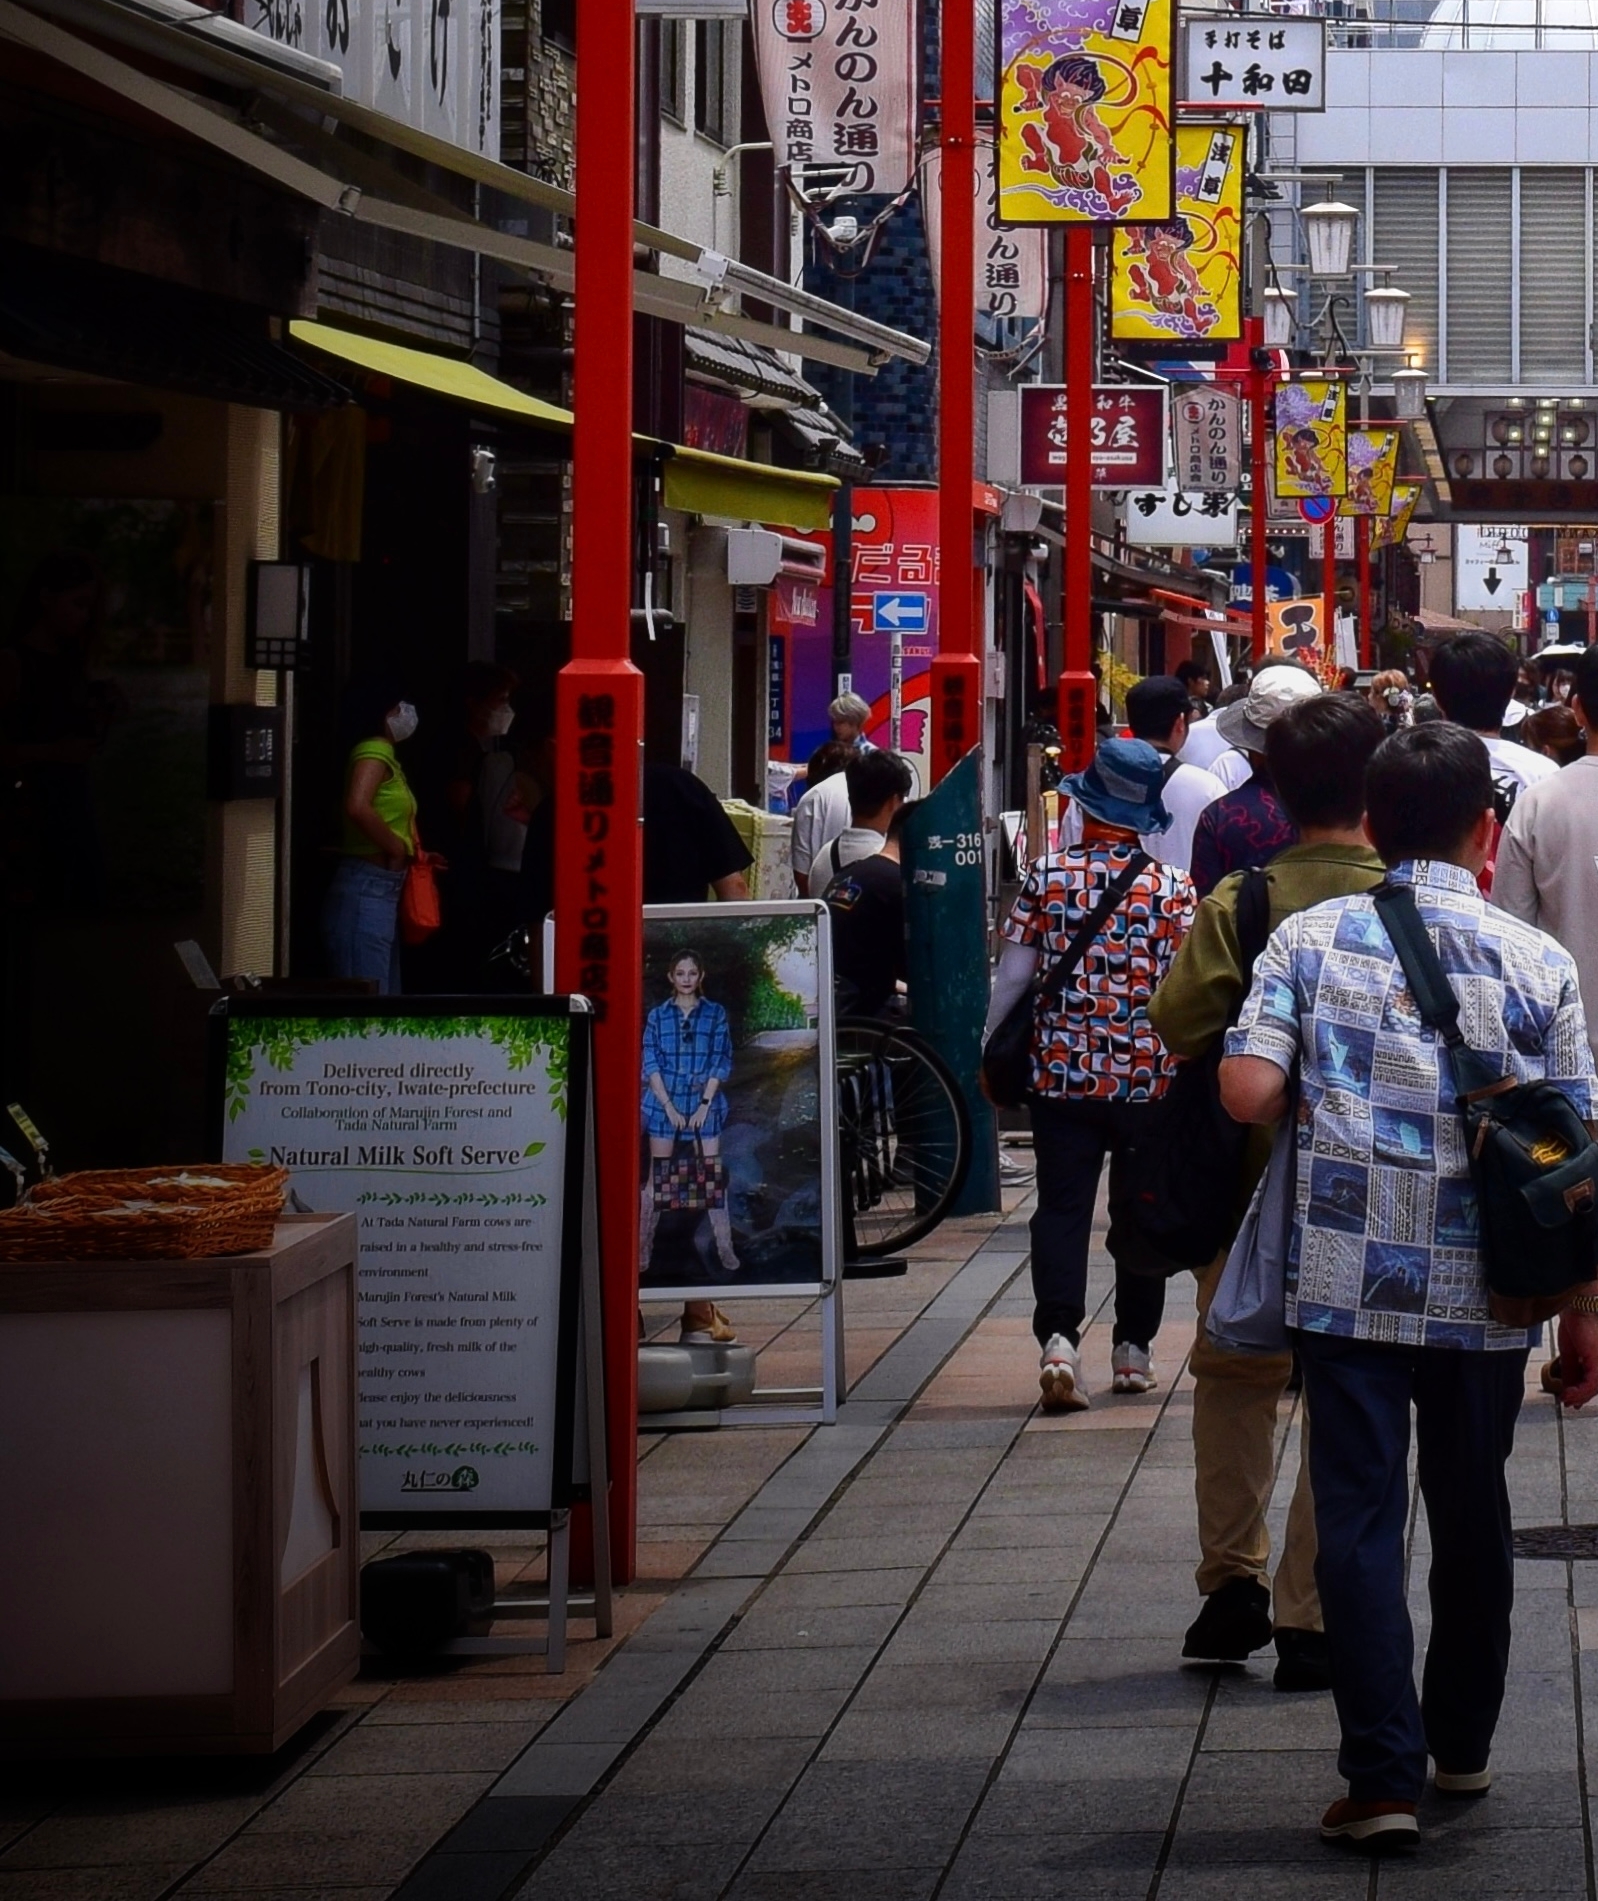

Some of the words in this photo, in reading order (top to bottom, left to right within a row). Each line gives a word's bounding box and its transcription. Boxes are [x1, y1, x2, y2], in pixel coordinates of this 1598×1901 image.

[1205, 30, 1285, 50] 手打そば
[1201, 61, 1312, 96] 十和田
[1203, 142, 1231, 197] 浅草
[1051, 394, 1135, 412] 黒和牛
[1208, 398, 1227, 484] かんのん通り
[955, 850, 982, 866] 001
[323, 1063, 404, 1079] Delivered
[410, 1063, 474, 1081] directly
[259, 1081, 301, 1096] from
[306, 1081, 392, 1099] Tono-city,
[398, 1080, 536, 1099] Iwate-prefecture
[281, 1106, 369, 1119] Collaboration
[372, 1106, 386, 1118] of
[389, 1106, 440, 1122] Marujin
[444, 1106, 483, 1118] Forest
[487, 1106, 512, 1118] and
[334, 1119, 367, 1131] Tada
[371, 1119, 419, 1131] Natural
[423, 1119, 457, 1131] Farm
[269, 1146, 349, 1166] Natural
[357, 1146, 405, 1166] Milk
[413, 1145, 455, 1165] Soft
[461, 1146, 520, 1165] Serve
[361, 1217, 374, 1227] At
[377, 1217, 405, 1227] Tada
[407, 1217, 449, 1227] Natural
[451, 1217, 481, 1227] Farm
[484, 1219, 511, 1227] cows
[514, 1219, 532, 1227] are
[359, 1242, 393, 1252] raised
[396, 1242, 407, 1252] in
[420, 1241, 460, 1254] healthy
[464, 1241, 485, 1252] and
[488, 1241, 543, 1252] stress-free
[358, 1267, 429, 1278] environment
[358, 1292, 400, 1304] Marujin
[403, 1291, 445, 1301] Forest's
[448, 1291, 489, 1302] Natural
[492, 1291, 518, 1302] Milk
[381, 1316, 411, 1327] Serve
[414, 1316, 423, 1327] is
[427, 1316, 457, 1327] made
[460, 1316, 486, 1327] from
[489, 1316, 524, 1329] plenty
[527, 1316, 539, 1327] of
[427, 1341, 454, 1352] fresh
[457, 1341, 482, 1352] milk
[485, 1341, 497, 1352] of
[499, 1341, 517, 1352] the
[398, 1369, 425, 1377] cows
[390, 1393, 420, 1405] enjoy
[424, 1392, 441, 1403] the
[444, 1392, 517, 1402] deliciousness
[376, 1419, 397, 1430] you
[400, 1417, 426, 1428] have
[430, 1419, 460, 1428] never
[464, 1417, 534, 1430] experienced!
